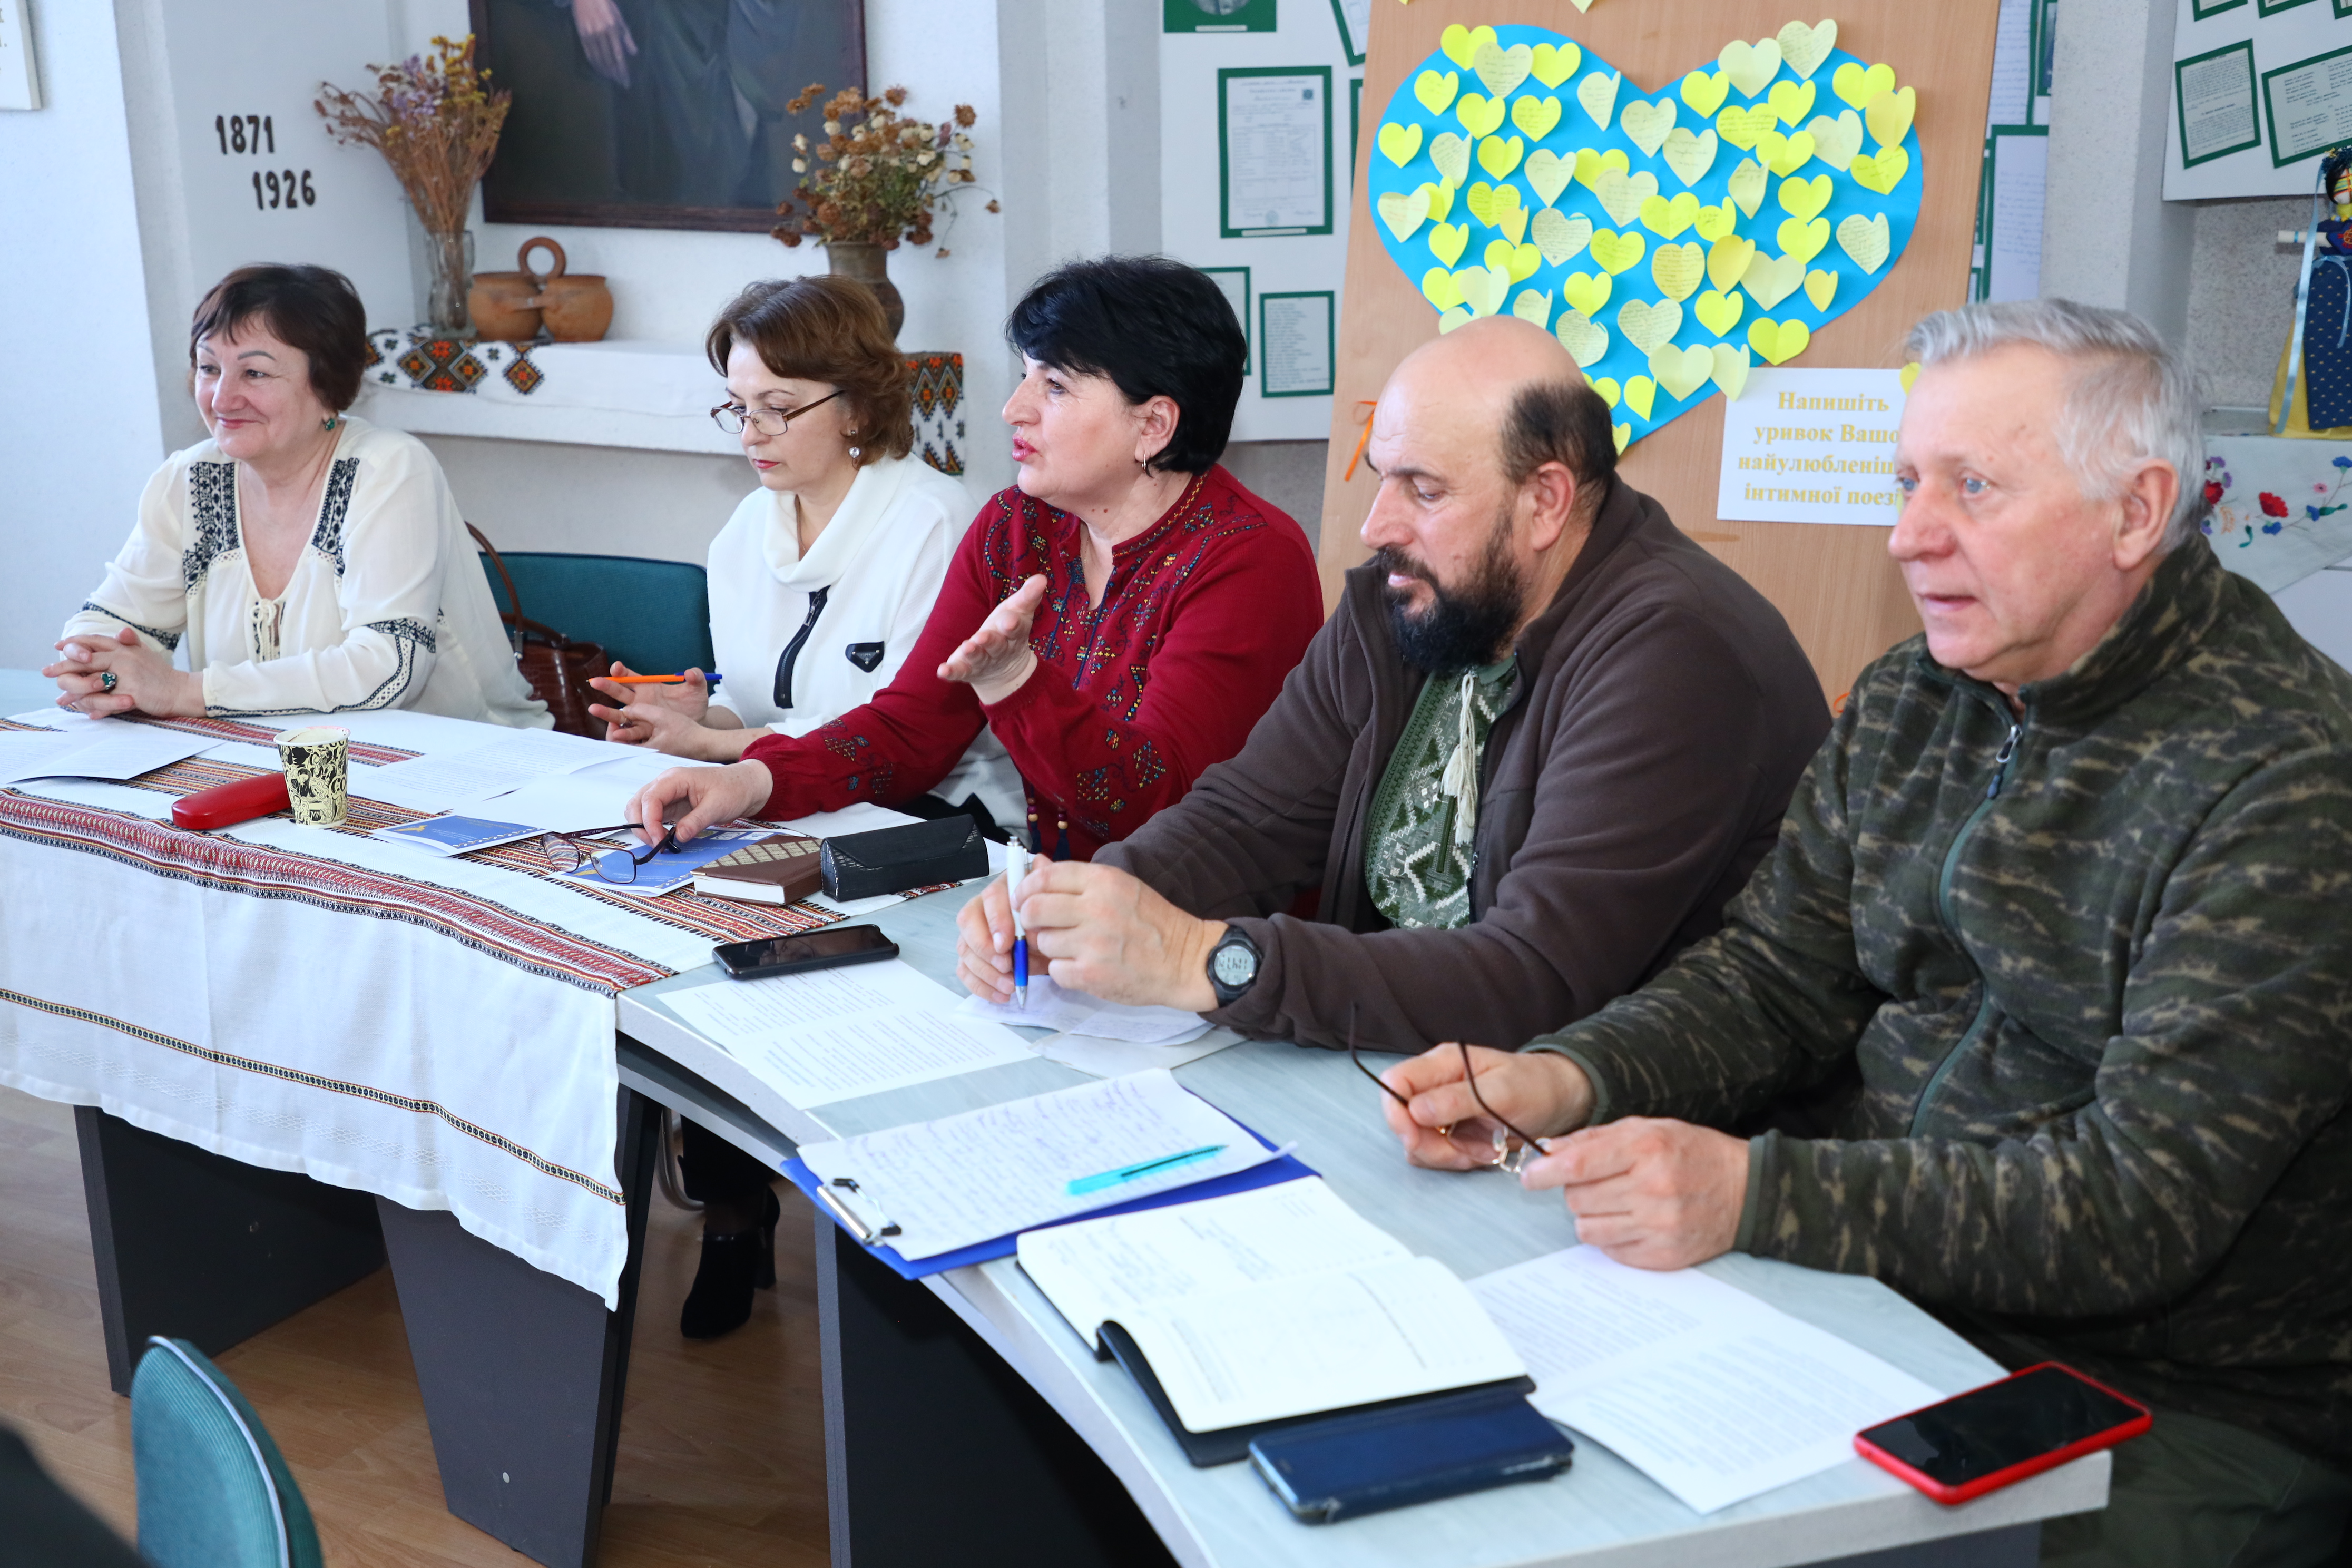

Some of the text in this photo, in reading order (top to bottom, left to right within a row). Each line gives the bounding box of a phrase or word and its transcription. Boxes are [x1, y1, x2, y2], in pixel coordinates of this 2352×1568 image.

[216, 115, 273, 155] 1871
[253, 169, 315, 210] 1926
[1778, 391, 1889, 411] Напишіть
[1754, 426, 1834, 444] уривок
[1745, 483, 1842, 503] інтимної
